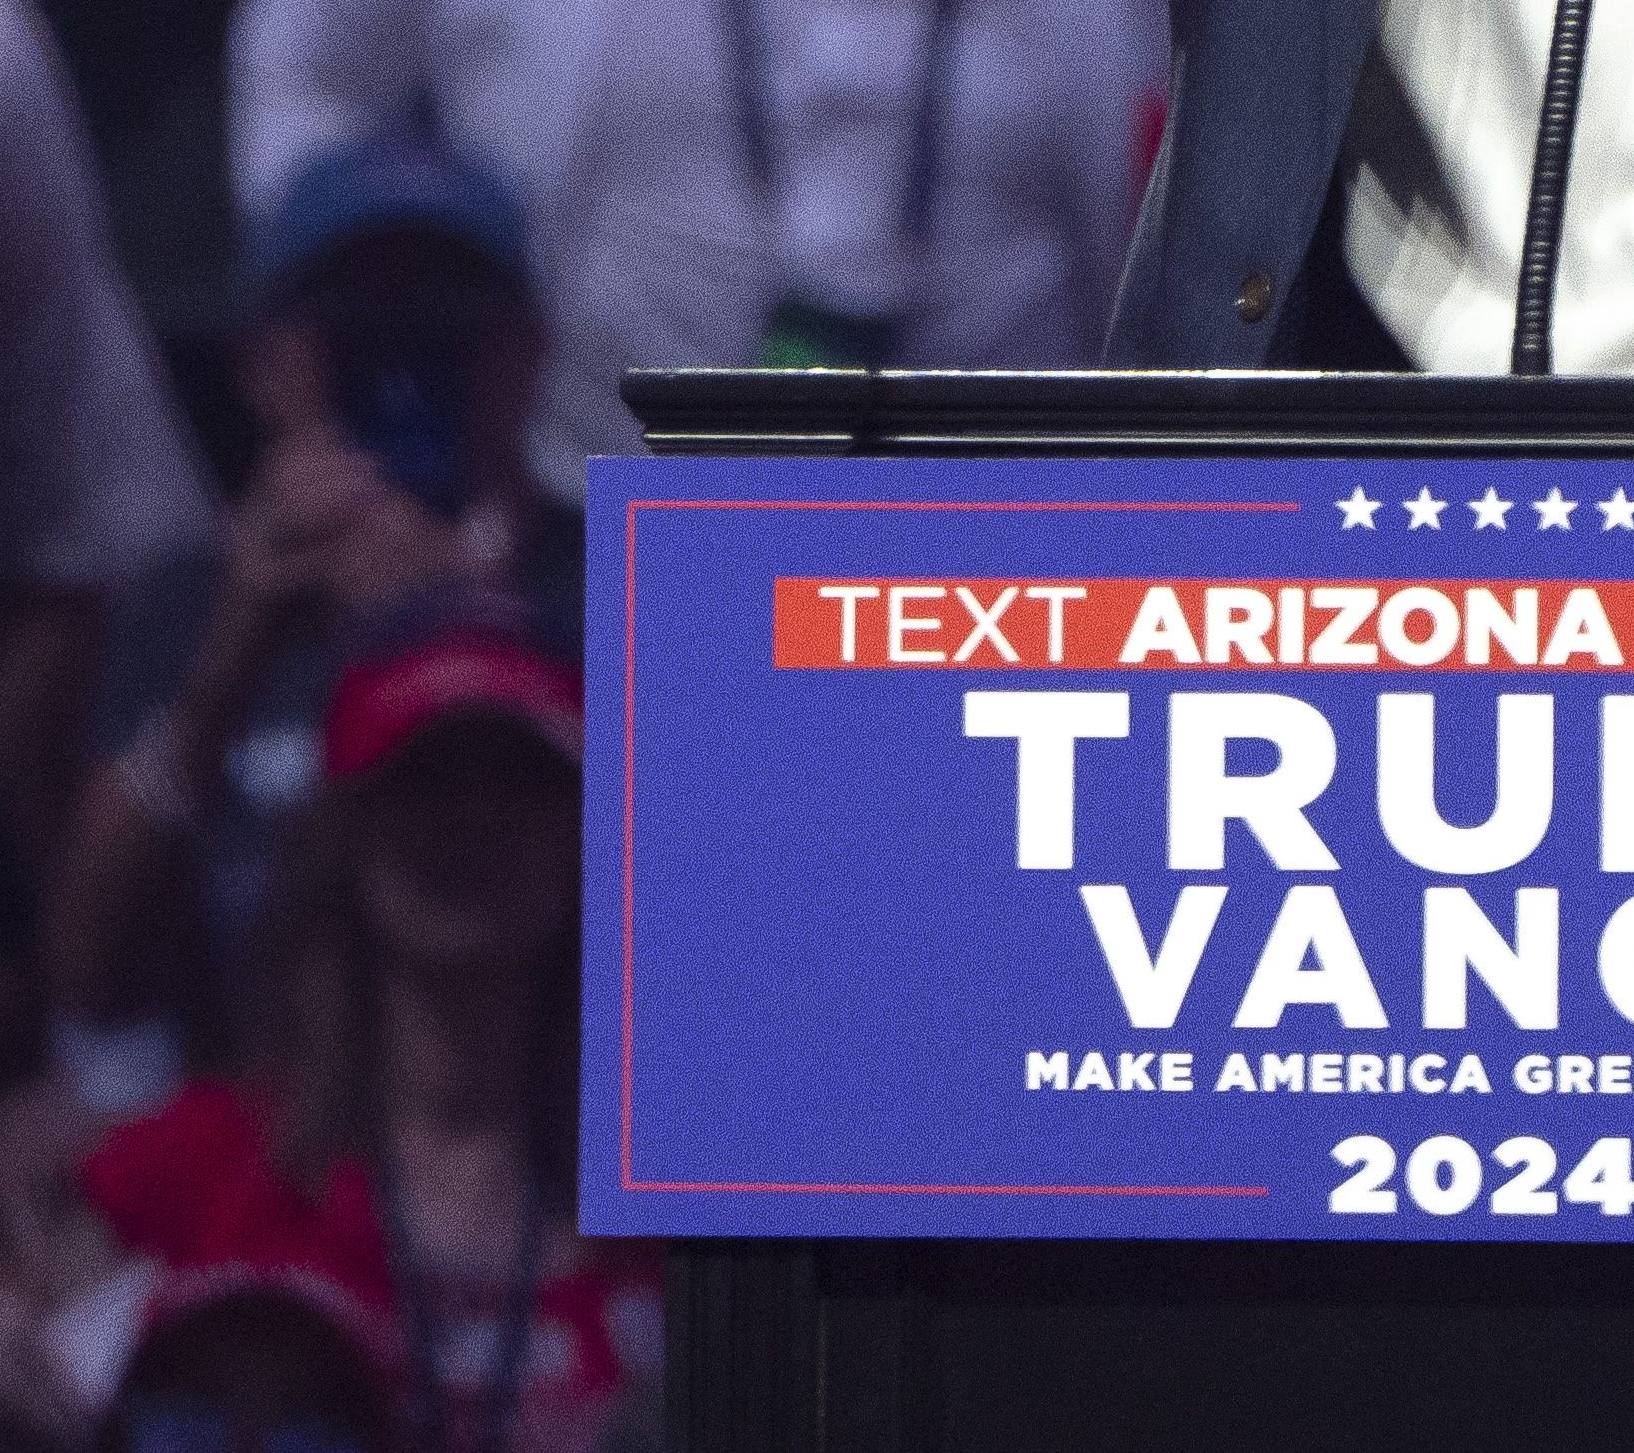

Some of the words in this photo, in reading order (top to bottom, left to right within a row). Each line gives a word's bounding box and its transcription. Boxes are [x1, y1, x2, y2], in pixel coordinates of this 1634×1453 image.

[818, 586, 1087, 663] TEXT
[1118, 585, 1624, 667] ARIZONA
[1026, 1051, 1193, 1092] MAKE
[1215, 1051, 1492, 1094] AMERICA
